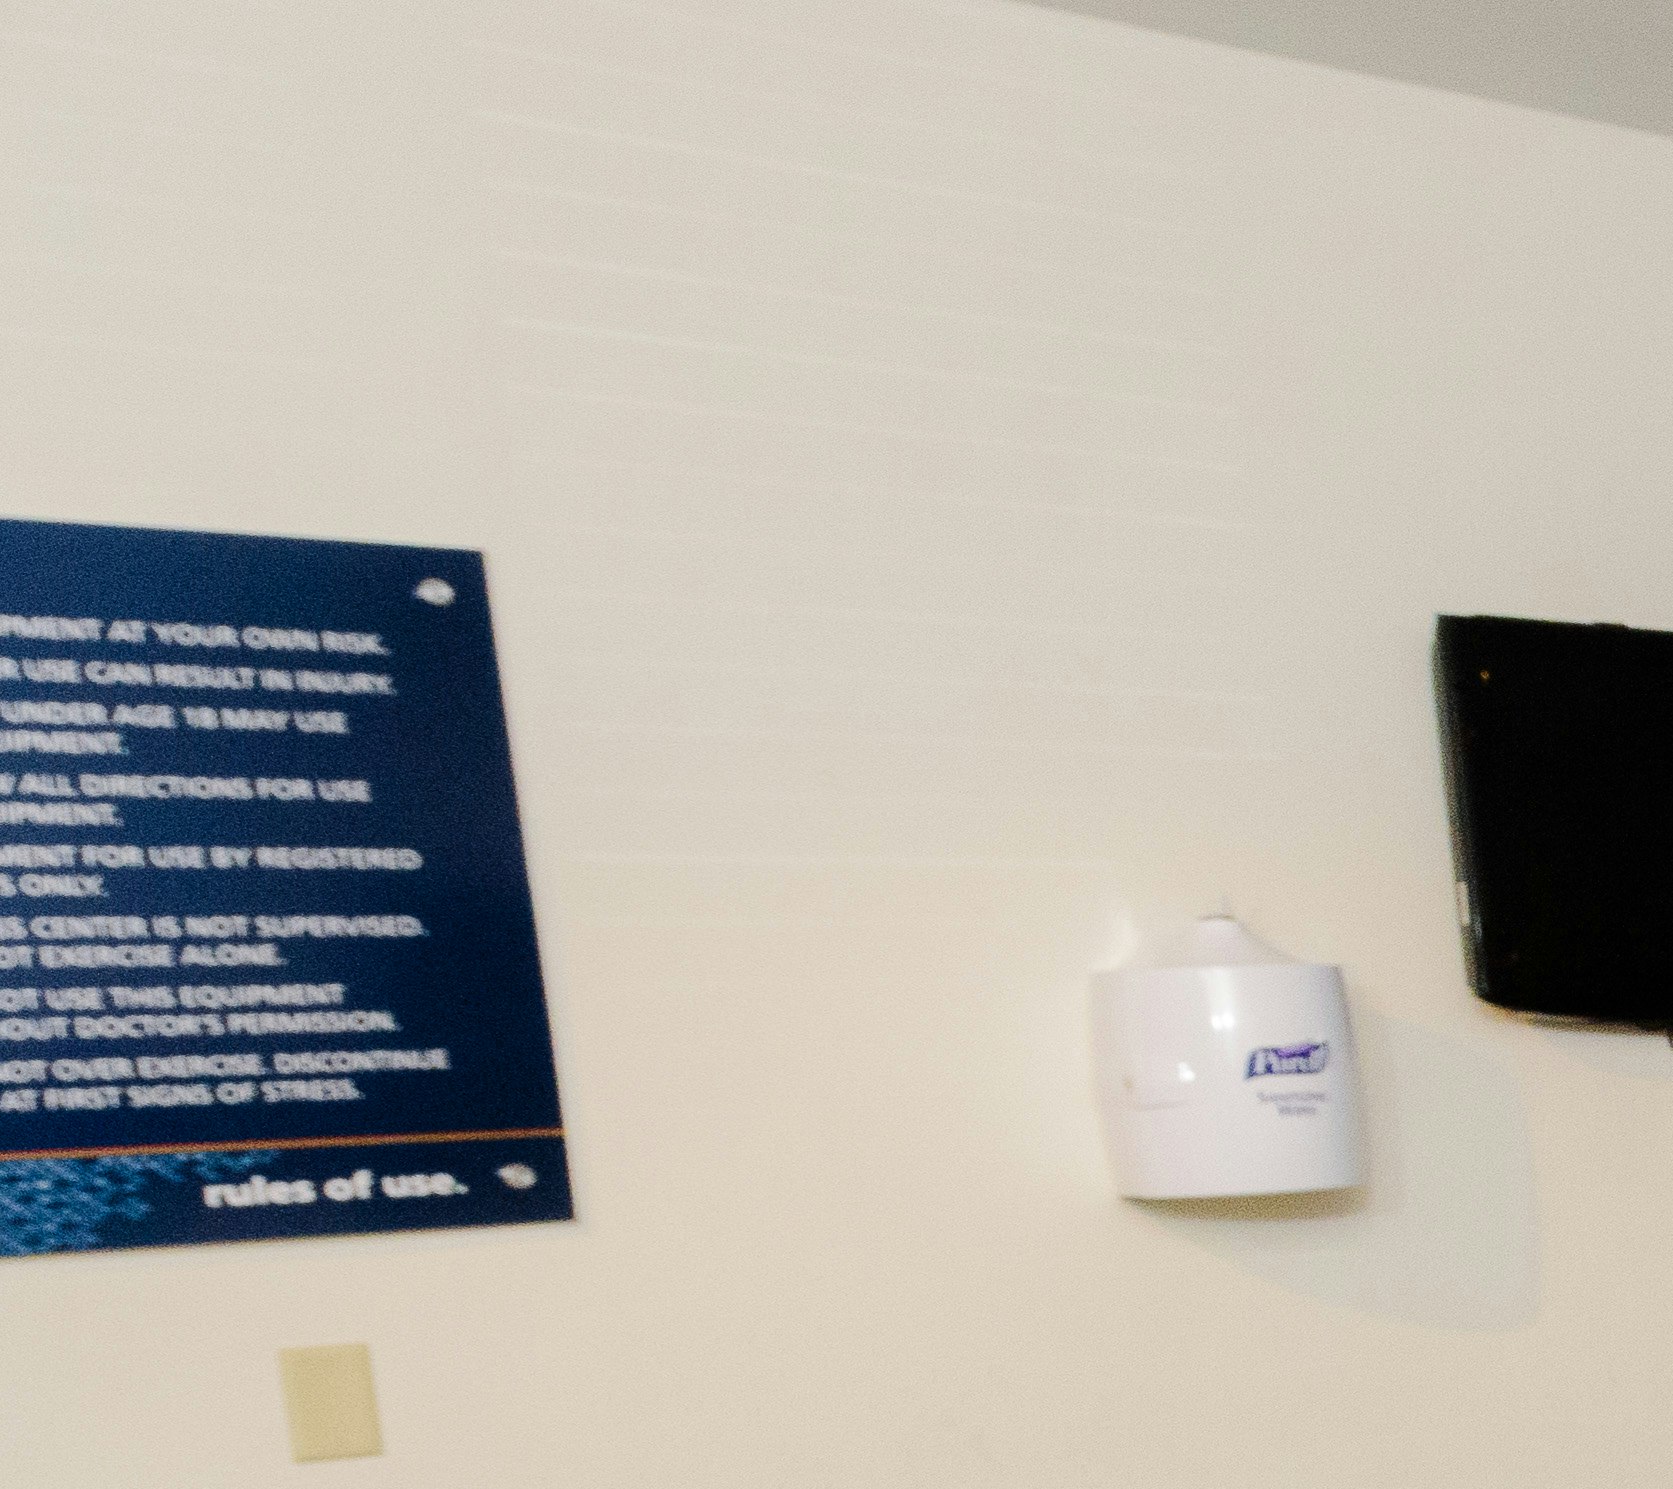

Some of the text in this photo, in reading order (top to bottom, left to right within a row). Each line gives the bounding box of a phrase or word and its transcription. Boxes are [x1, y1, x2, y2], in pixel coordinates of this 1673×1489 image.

[107, 620, 147, 643] AT
[151, 622, 241, 648] YOUR
[242, 626, 319, 651] OWN
[321, 630, 391, 656] RISK.
[22, 657, 81, 683] USE
[84, 660, 152, 685] CAN
[154, 663, 256, 689] RESULT
[259, 668, 293, 690] IN
[0, 700, 108, 725] UNDER
[112, 703, 177, 728] AGE
[220, 707, 290, 731] MAY
[293, 710, 349, 733] USE
[18, 773, 77, 797] ALL
[79, 774, 254, 799] DIRECTIONS
[255, 777, 315, 800] FOR
[316, 779, 372, 801] USE
[81, 845, 144, 869] FOR
[149, 846, 204, 869] USE
[210, 847, 253, 869] BY
[255, 847, 424, 870] REGISTERED
[30, 916, 149, 940] CENTER
[152, 916, 183, 939] IS
[184, 915, 250, 939] NOT
[39, 945, 174, 968] EXERCISE
[44, 987, 102, 1011] USE
[108, 986, 176, 1009] THIS
[178, 983, 345, 1007] EQUIPMENT
[0, 1016, 69, 1041] OUT
[227, 1010, 402, 1035] PERMISSION.
[50, 1056, 134, 1082] OVER
[273, 1048, 452, 1074] DISCONTINUE
[43, 1085, 122, 1109] FIRST
[125, 1083, 214, 1107] SIGNS
[216, 1081, 259, 1105] OF
[202, 1174, 318, 1207] rules
[323, 1168, 374, 1201] of
